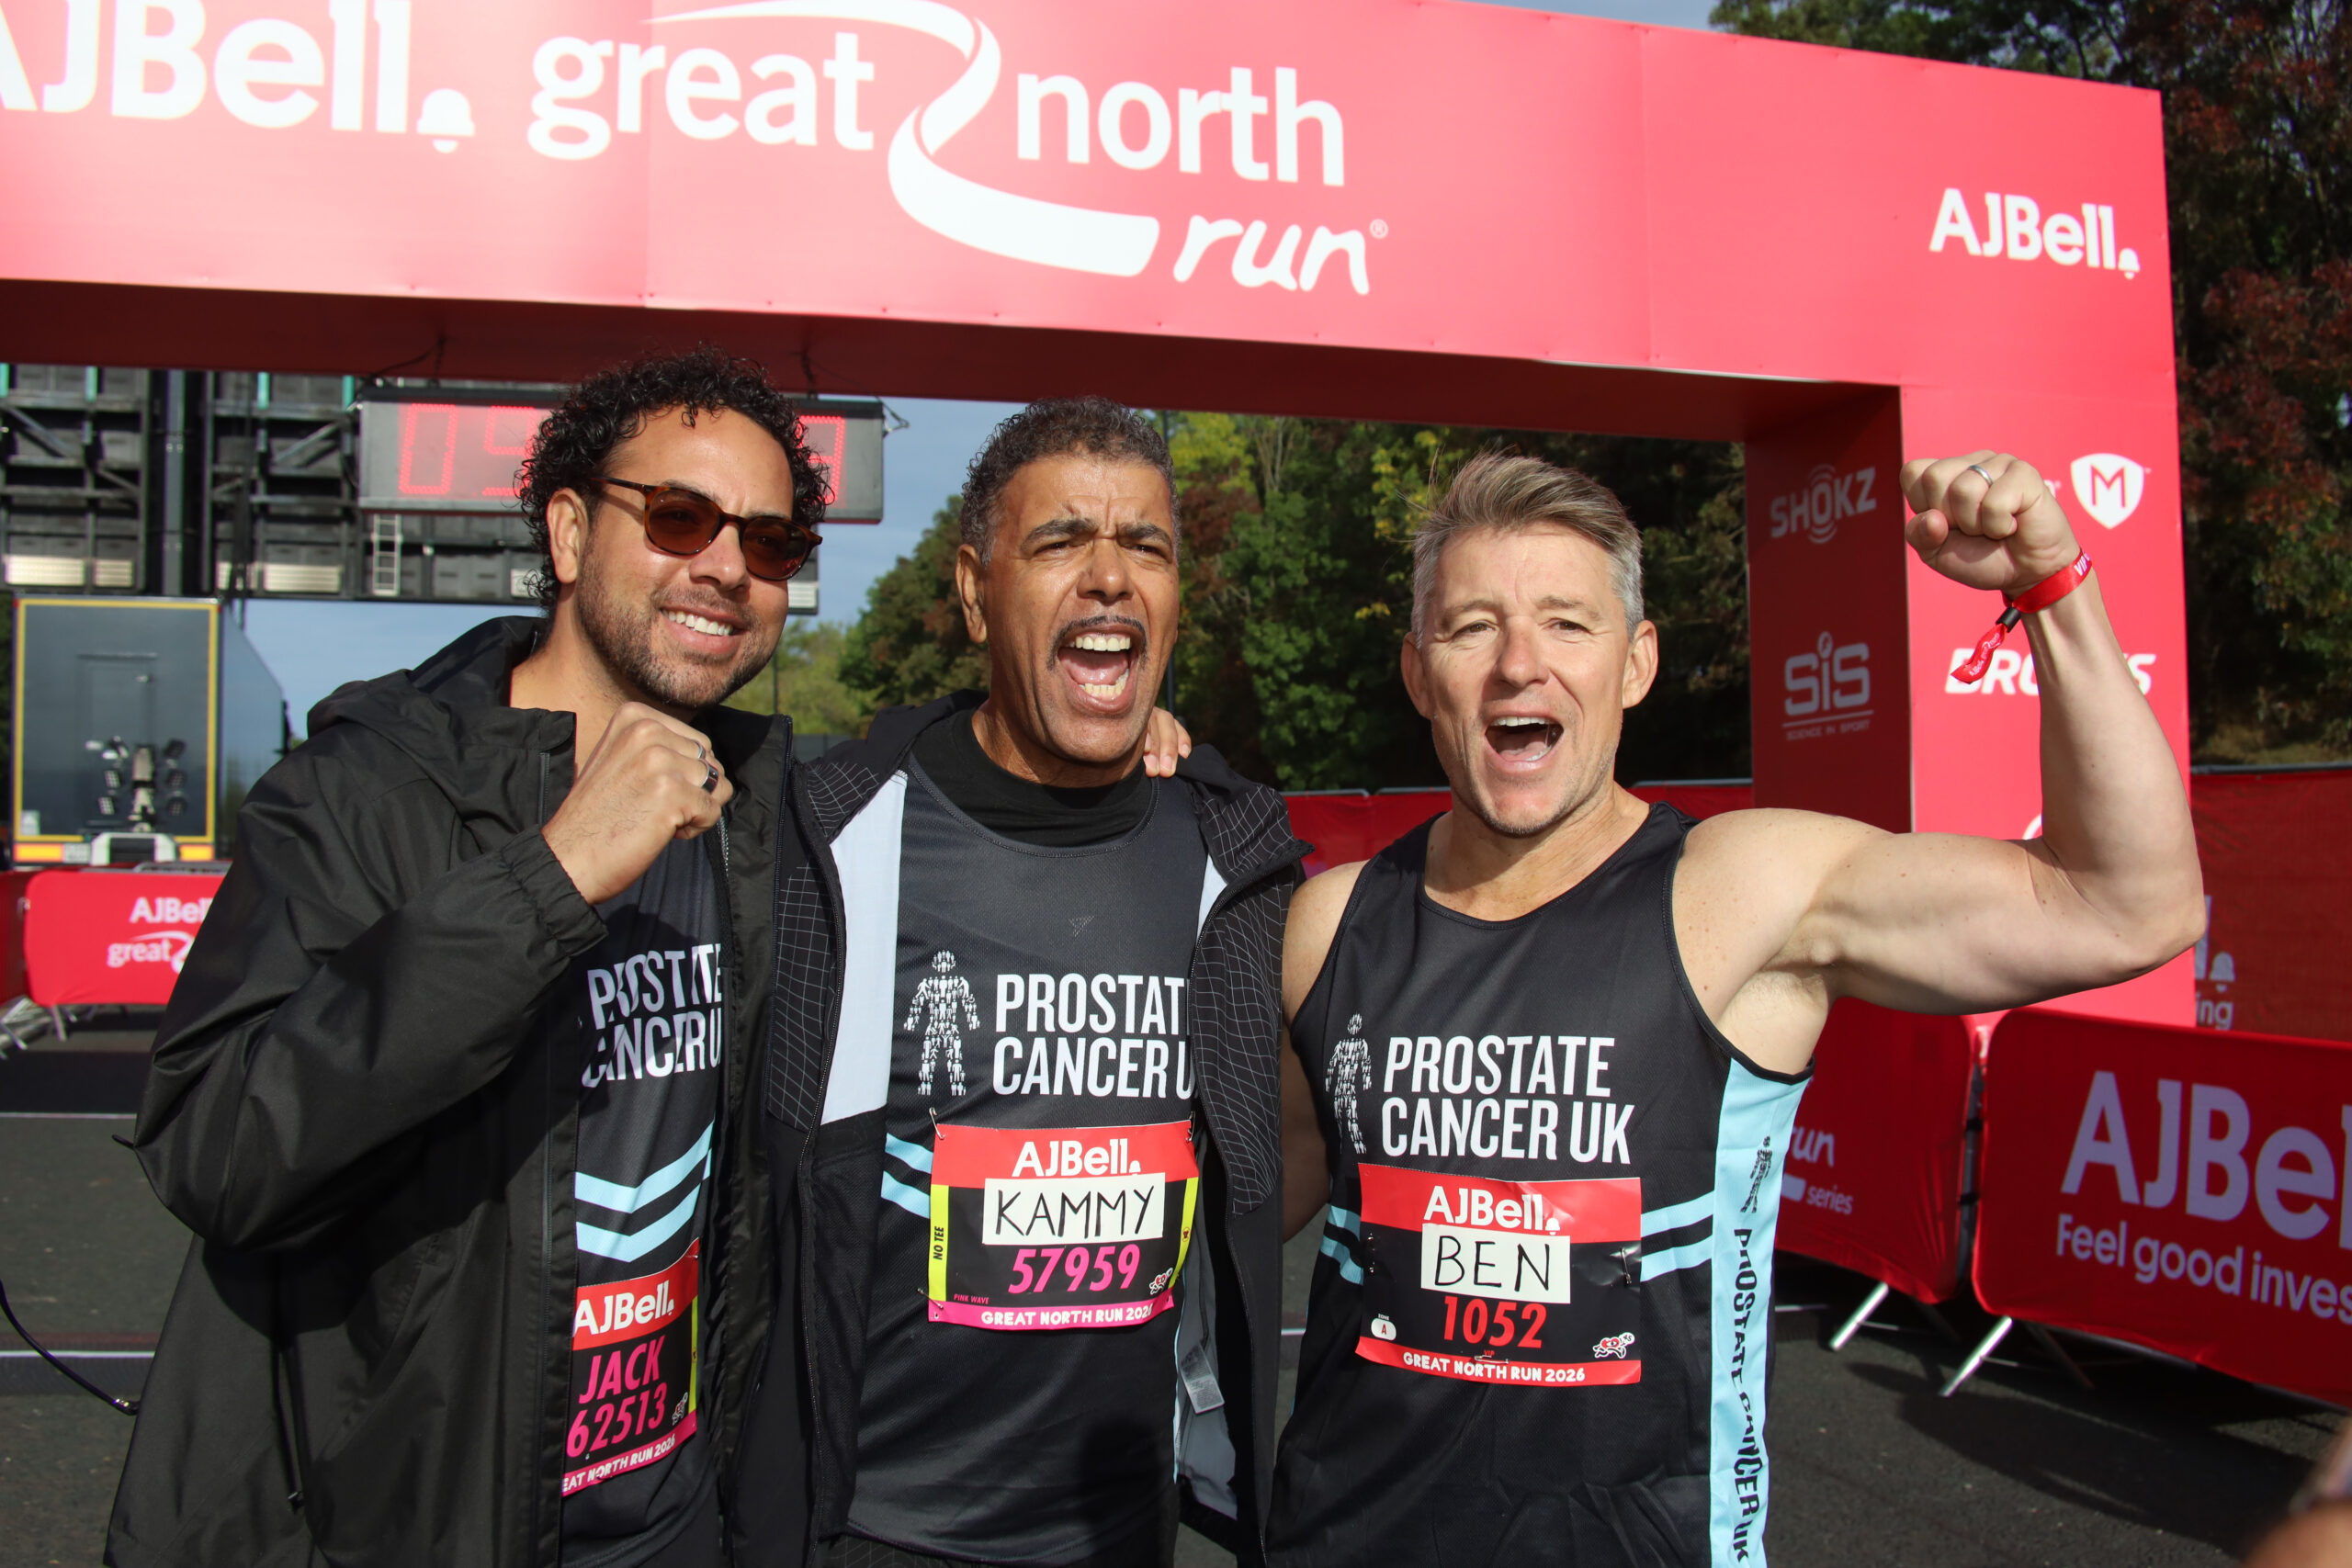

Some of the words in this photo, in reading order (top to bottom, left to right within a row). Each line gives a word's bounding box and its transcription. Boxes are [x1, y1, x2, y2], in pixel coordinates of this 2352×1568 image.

[527, 31, 875, 160] great
[1018, 66, 1345, 187] north
[1770, 467, 1877, 538] SHOKZ
[107, 937, 173, 967] great
[995, 973, 1190, 1035] PROSTAT
[992, 1037, 1170, 1097] CANCER
[1384, 1035, 1615, 1097] PROSTATE
[1382, 1097, 1559, 1160] CANCER
[1569, 1101, 1634, 1165] UK
[995, 1185, 1154, 1239] KAMMY
[1806, 1183, 1853, 1215] series
[933, 1245, 943, 1260] NO
[934, 1225, 944, 1242] TEE
[2056, 1213, 2127, 1267] Feel
[2133, 1246, 2244, 1296] good
[1007, 1244, 1140, 1294] 57959
[1434, 1235, 1550, 1292] BEN
[954, 1293, 969, 1303] PINK
[971, 1295, 989, 1305] WAVE
[981, 1311, 1036, 1325] GREAT
[1040, 1309, 1091, 1325] NORTH
[1095, 1308, 1123, 1324] RUN
[1443, 1296, 1547, 1349] 1052
[578, 1335, 665, 1404] JACK
[1404, 1352, 1450, 1372] GREAT
[1453, 1360, 1508, 1380] NORTH
[1510, 1366, 1541, 1382] RUN
[1544, 1368, 1585, 1382] 2026
[566, 1382, 667, 1458] 62513
[588, 1457, 628, 1483] NORTH
[629, 1446, 651, 1466] RUN
[654, 1432, 675, 1458] 2026
